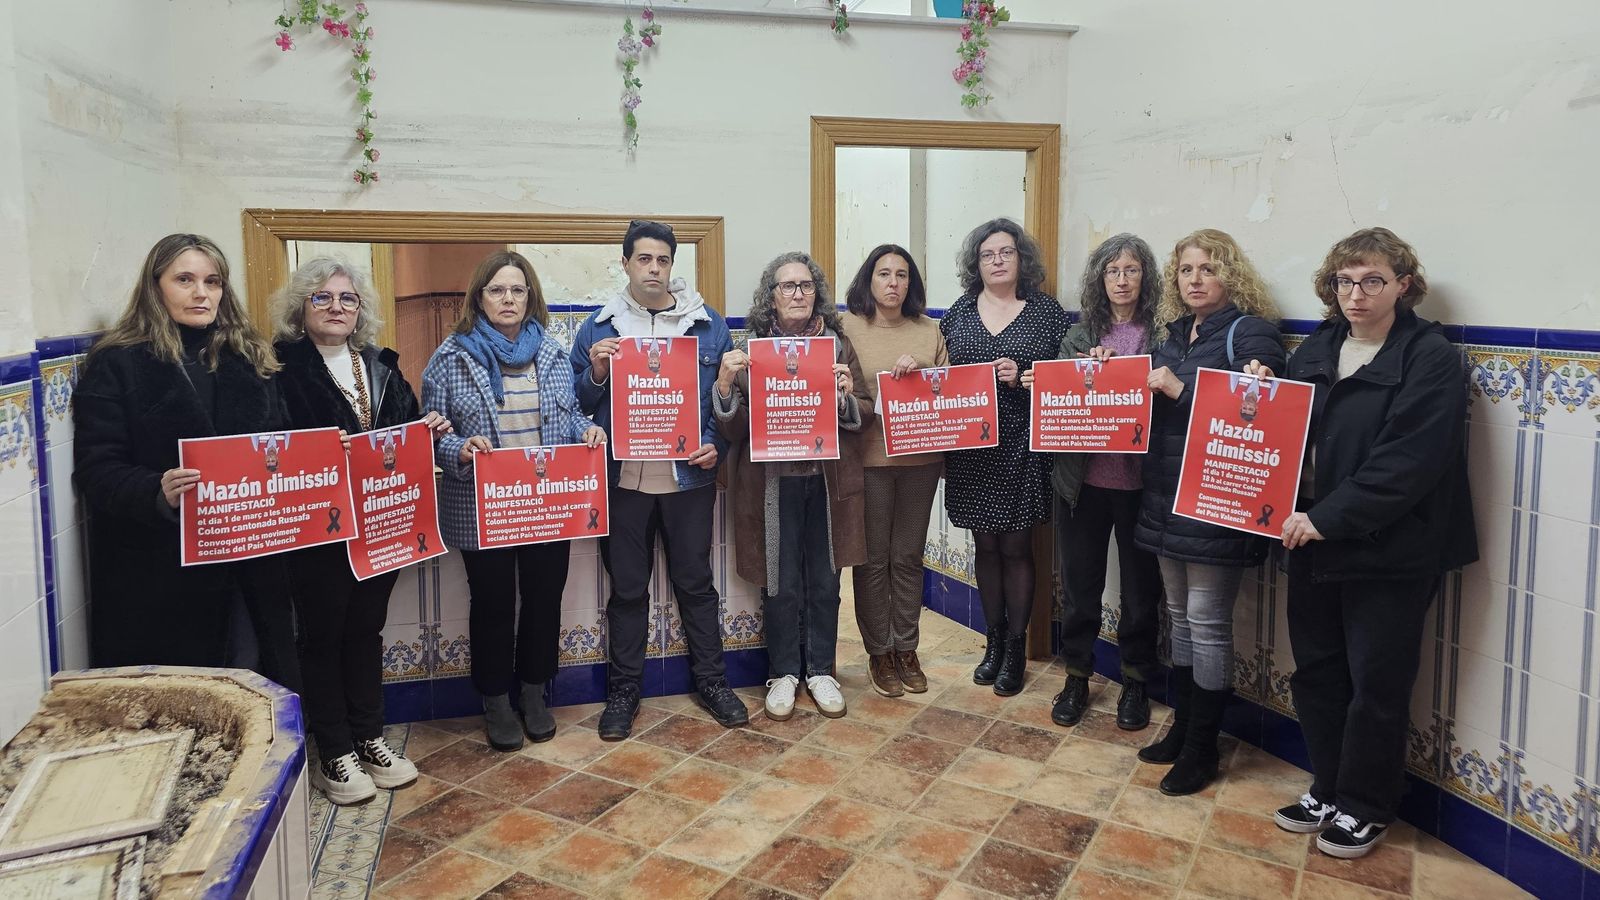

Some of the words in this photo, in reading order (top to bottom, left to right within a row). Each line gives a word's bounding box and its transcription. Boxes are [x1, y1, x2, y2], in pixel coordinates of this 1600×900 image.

[628, 374, 669, 388] Mazón
[766, 376, 807, 390] Mazón
[628, 390, 684, 405] dimissió
[766, 392, 821, 407] dimissió
[888, 398, 929, 414] Mazón
[933, 392, 988, 410] dimissió
[1041, 391, 1081, 406] Mazón
[1085, 390, 1143, 406] dimissió
[629, 407, 678, 415] MANIFESTACIÓ
[767, 409, 816, 417] MANIFESTACIÓ
[890, 412, 939, 423] MANIFESTACIÓ
[1041, 408, 1091, 416] MANIFESTACIÓ
[1210, 418, 1264, 443] Mazón
[1207, 438, 1280, 466] dimissió
[1205, 459, 1269, 477] MANIFESTACIÓ
[198, 477, 261, 502] Mazón
[267, 466, 338, 494] dimissió
[362, 471, 405, 494] Mazón
[484, 481, 532, 499] Mazón
[536, 475, 598, 495] dimissió
[198, 496, 275, 515] MANIFESTACIÓ
[298, 504, 306, 512] al
[307, 501, 331, 510] carrer
[363, 484, 420, 513] dimissió
[485, 496, 543, 509] MANIFESTACIÓ
[364, 504, 415, 524] MANIFESTACIÓ
[508, 514, 544, 523] cantonada
[546, 512, 572, 520] Russafa
[198, 527, 230, 535] Colom
[232, 519, 276, 531] cantonada
[278, 513, 310, 524] Russafa
[198, 537, 246, 547] Convoquen
[261, 527, 300, 539] moviments
[198, 544, 231, 556] socials
[233, 543, 246, 552] del
